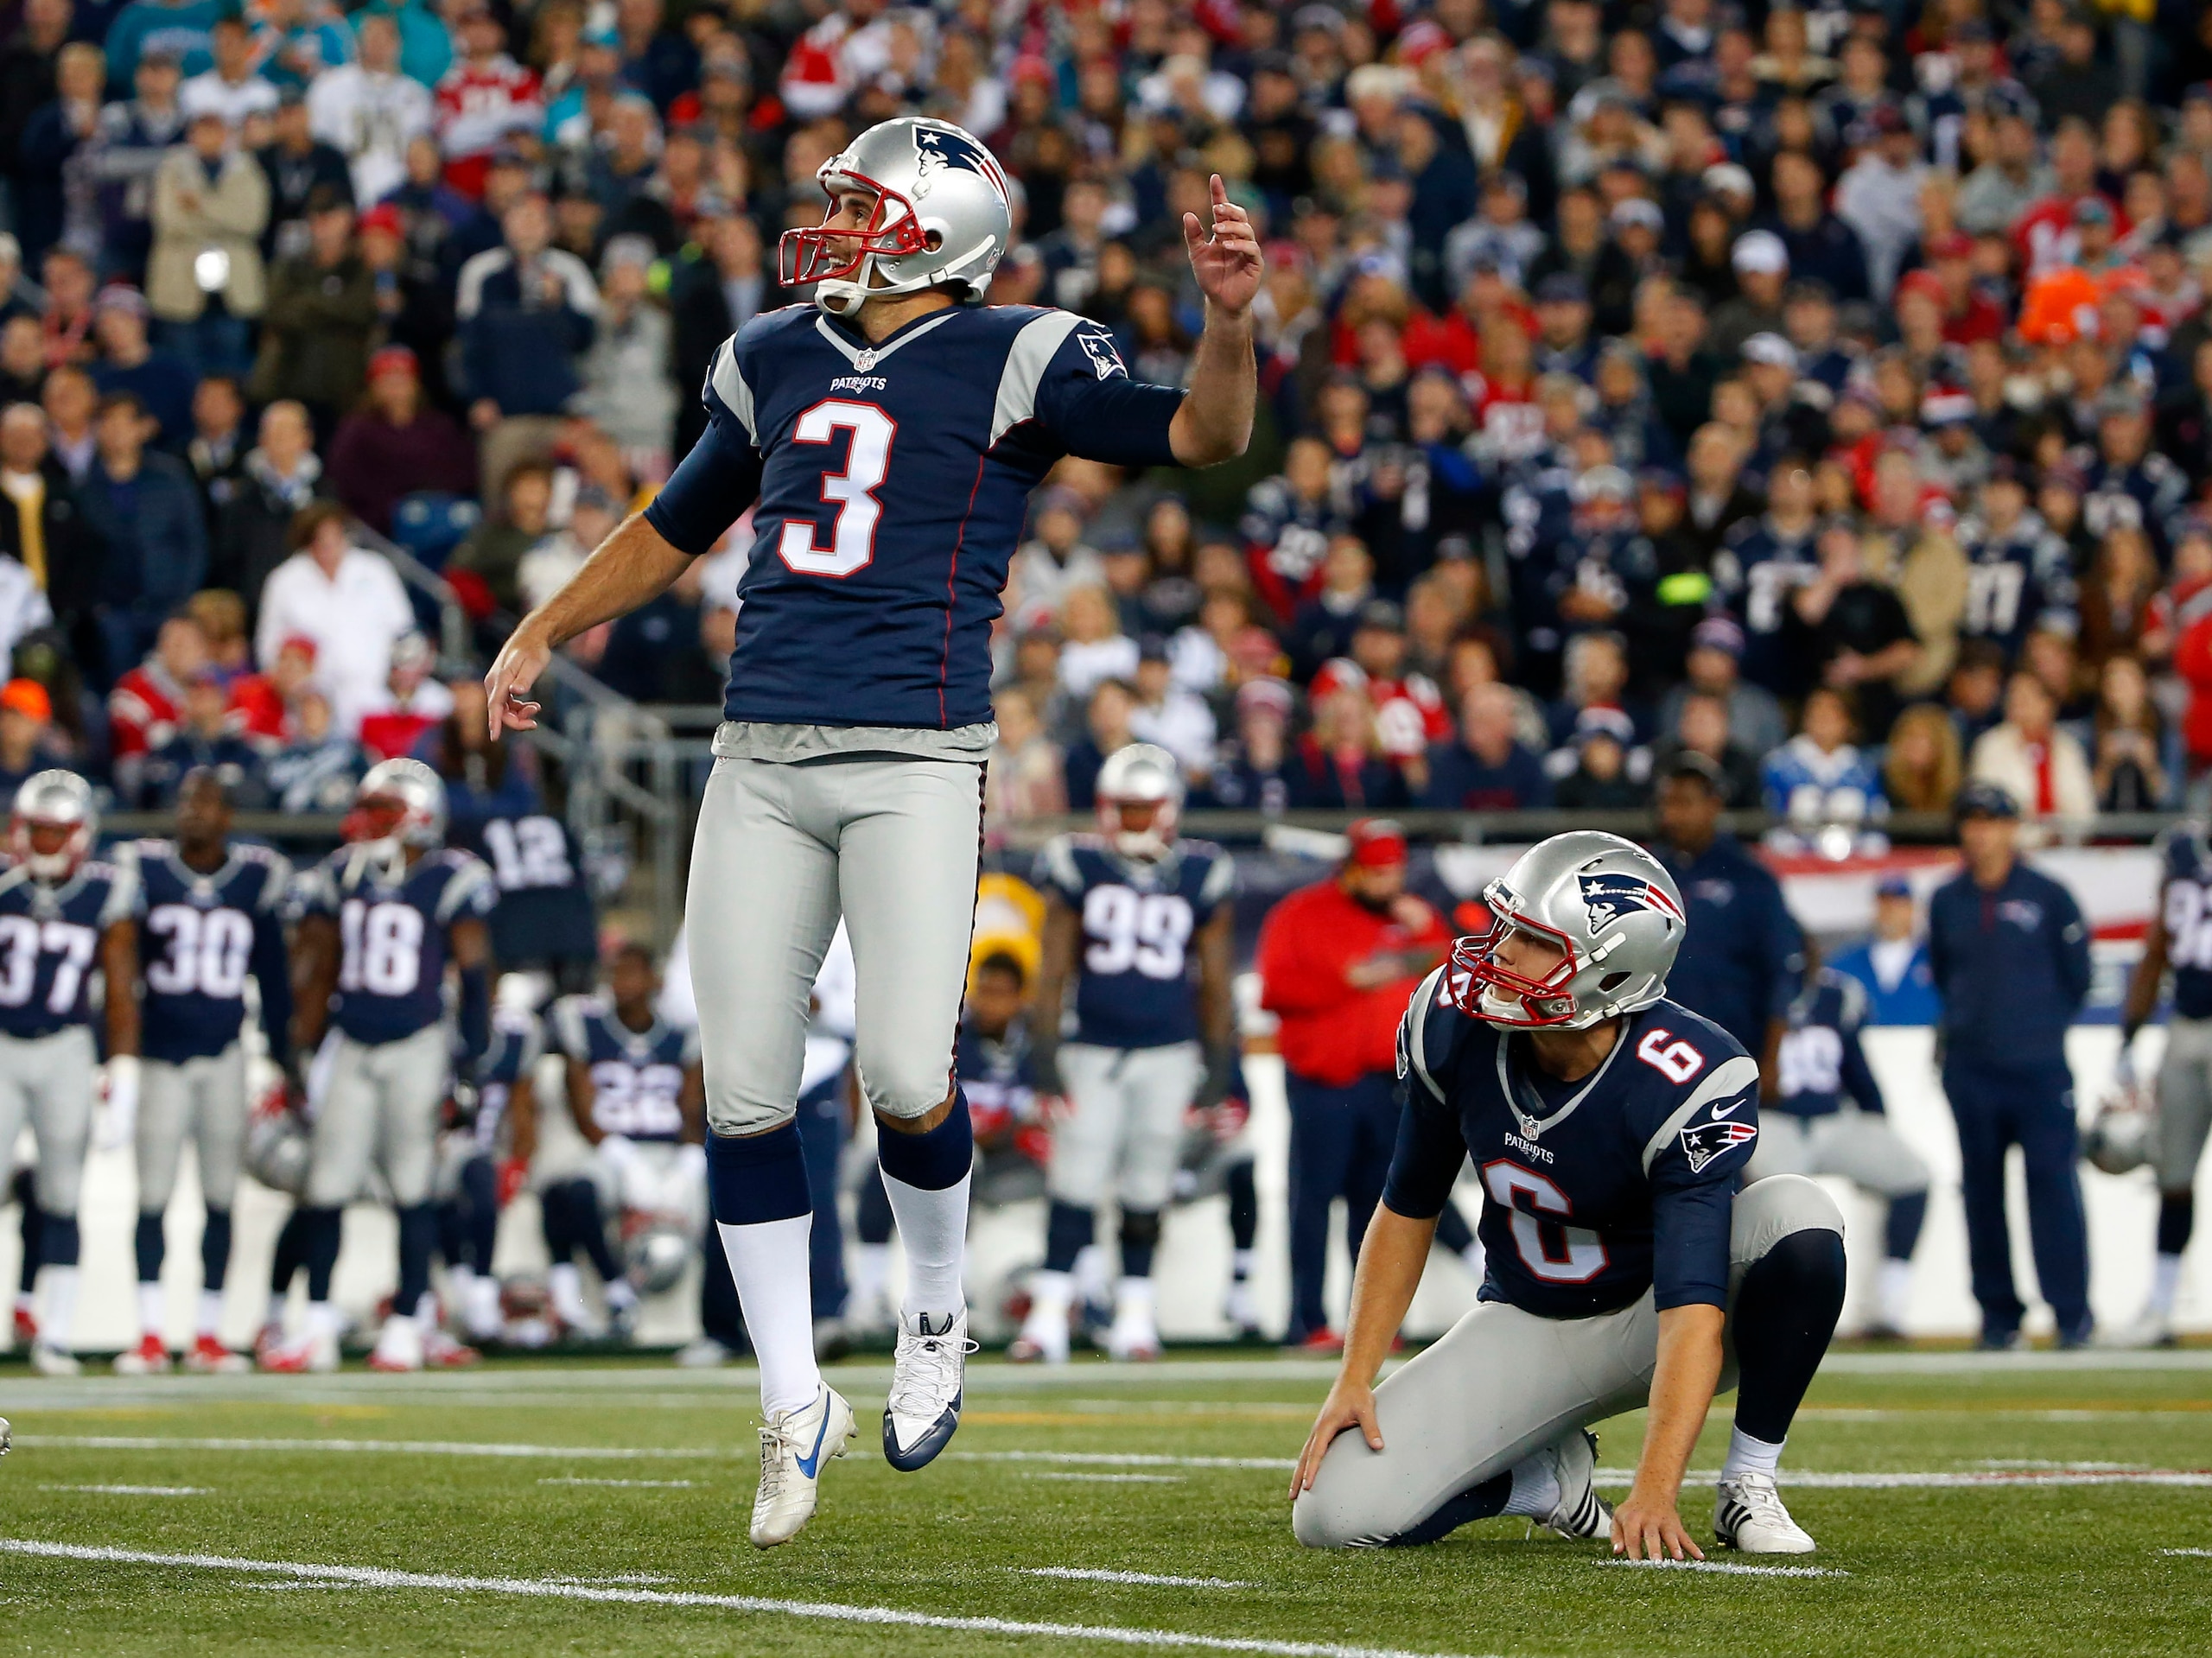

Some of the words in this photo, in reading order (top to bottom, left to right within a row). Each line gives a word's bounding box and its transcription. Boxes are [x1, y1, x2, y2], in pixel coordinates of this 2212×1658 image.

[830, 376, 887, 391] PATRIOTS
[856, 356, 873, 368] NFL
[778, 397, 899, 579] 3
[483, 815, 574, 890] 12
[0, 914, 96, 1013] 37
[147, 904, 253, 997] 30
[340, 899, 424, 996] 18
[1084, 884, 1193, 979] 99
[1637, 1027, 1706, 1085] 6
[1504, 1132, 1554, 1164] PATRIOTS
